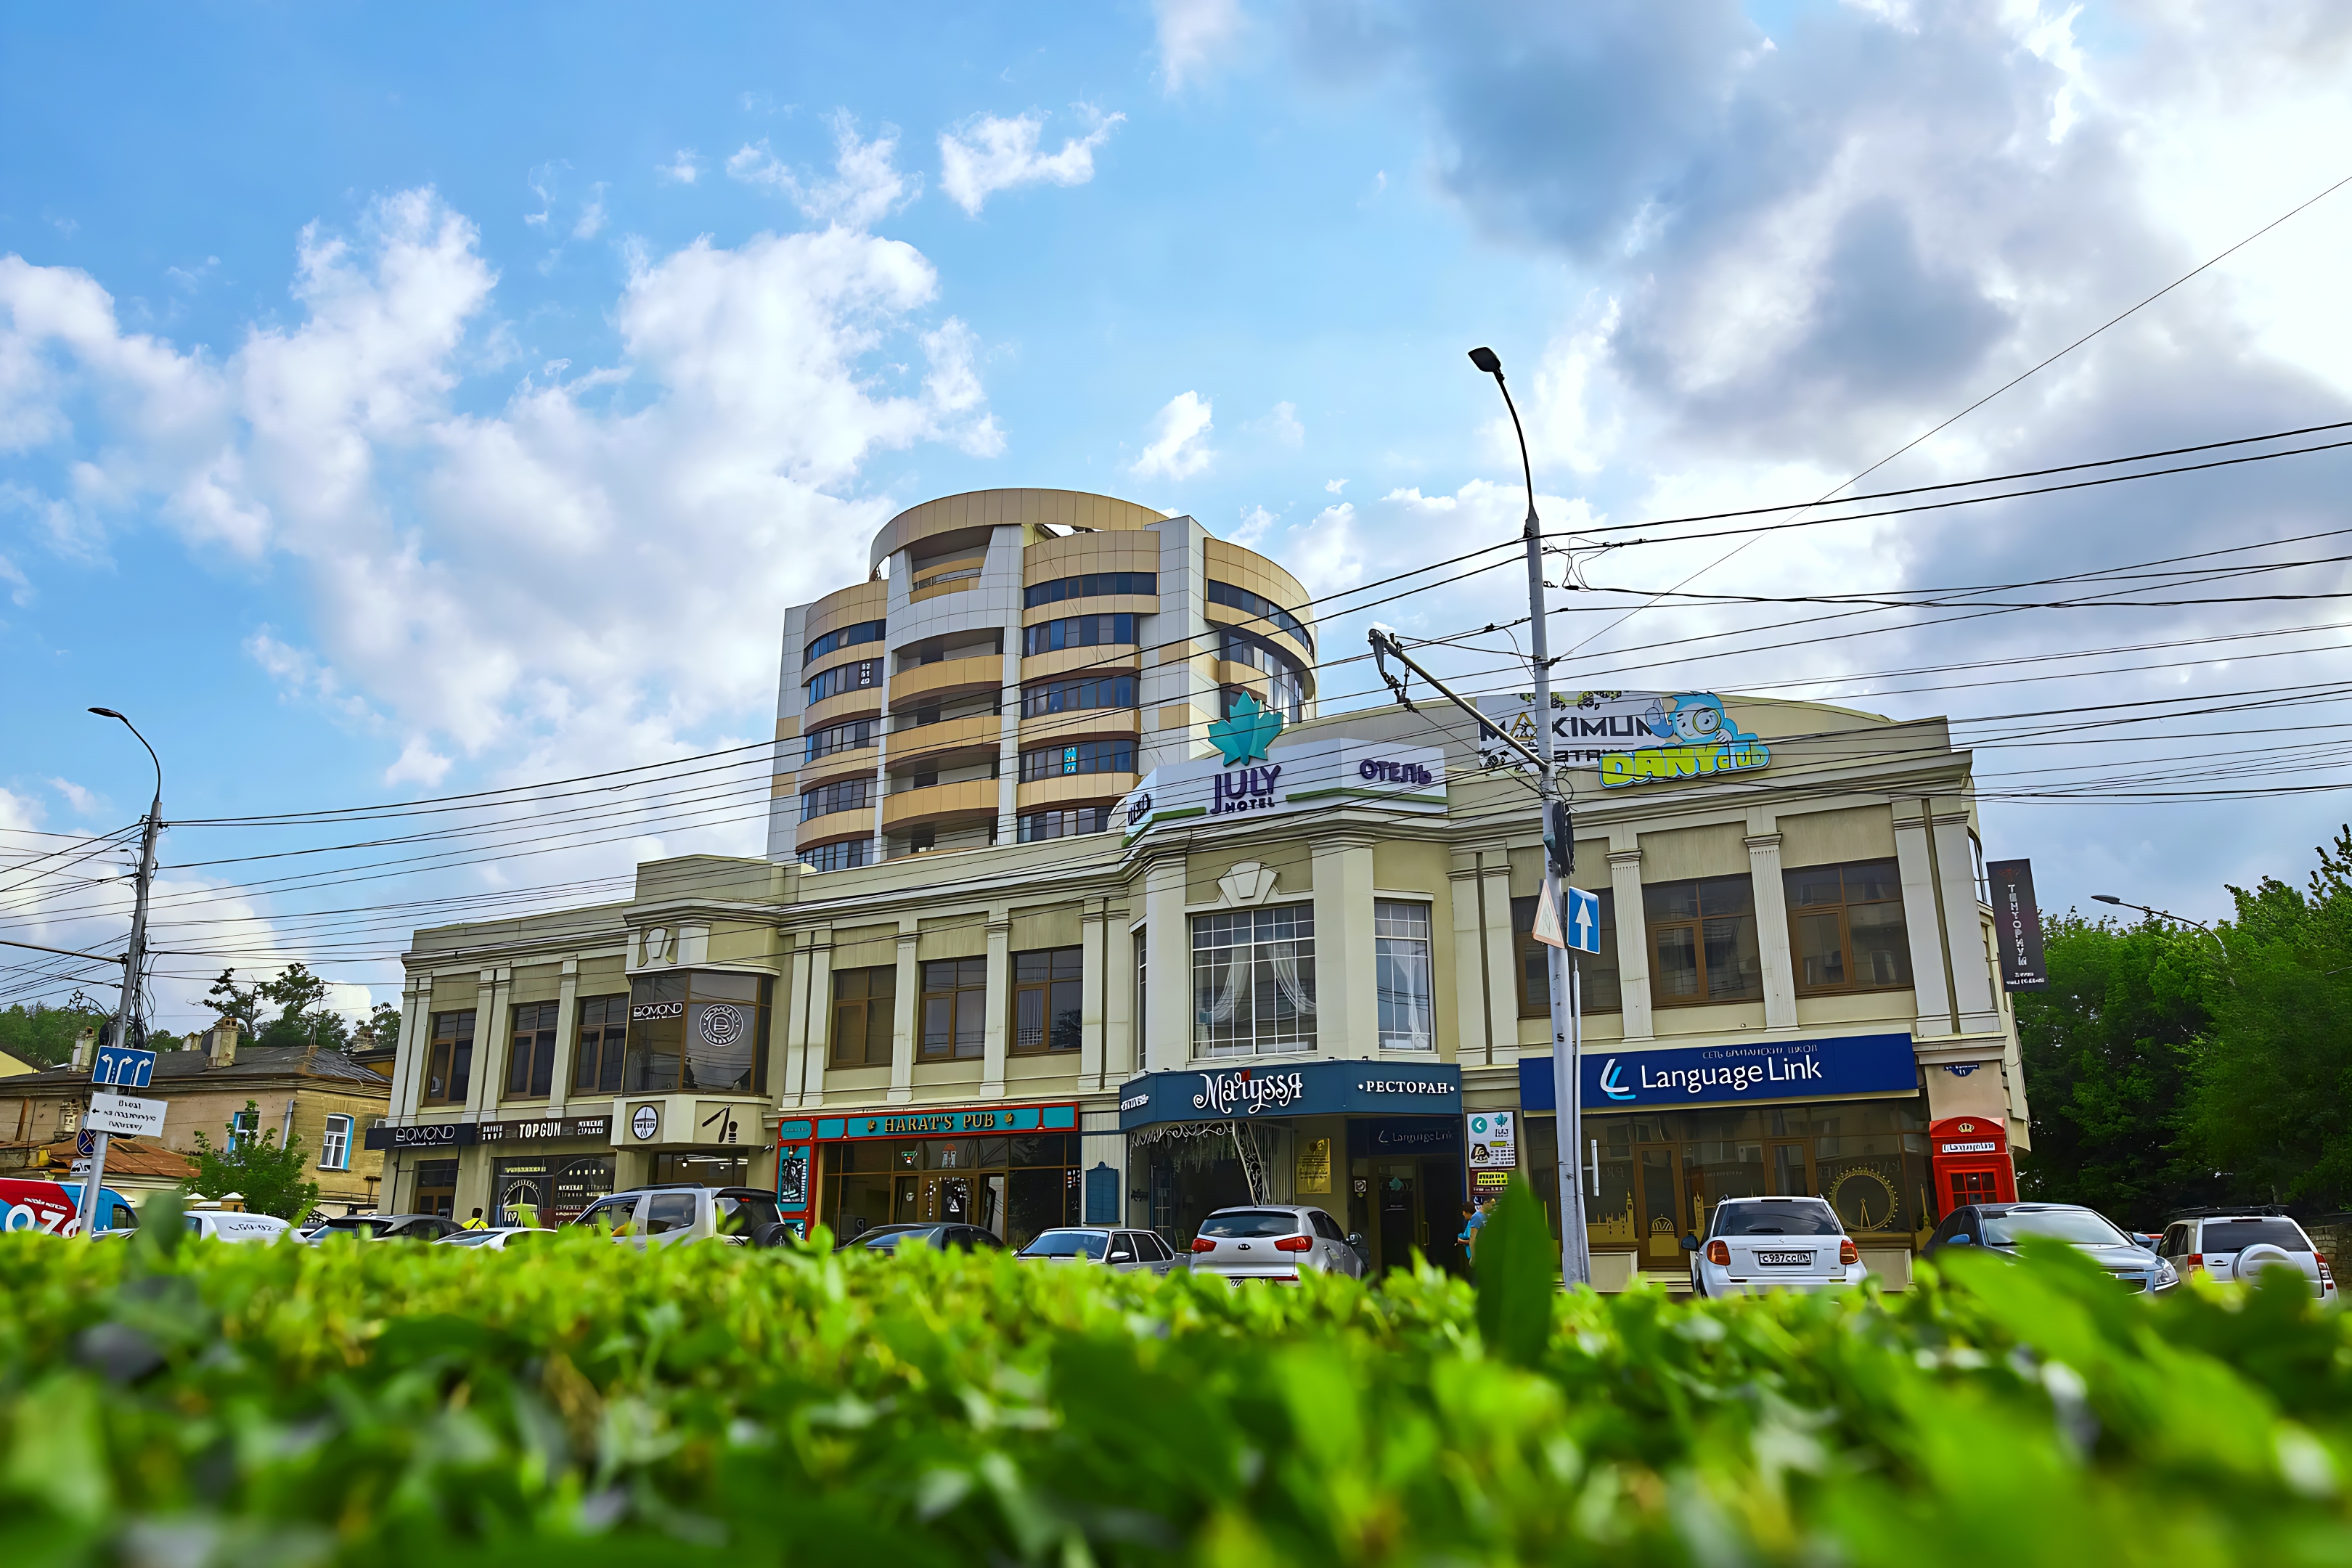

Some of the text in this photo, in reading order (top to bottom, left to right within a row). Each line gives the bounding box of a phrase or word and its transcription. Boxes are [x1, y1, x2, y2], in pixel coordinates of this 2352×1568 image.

[1359, 759, 1432, 784] ОТЕЛЬ
[1600, 745, 1720, 788] DANY
[1210, 764, 1282, 814] JULY
[1225, 796, 1275, 812] HOTEL
[1641, 1065, 1764, 1093] Language
[1768, 1054, 1823, 1081] Link
[884, 1113, 995, 1132] HARAT'S PUB
